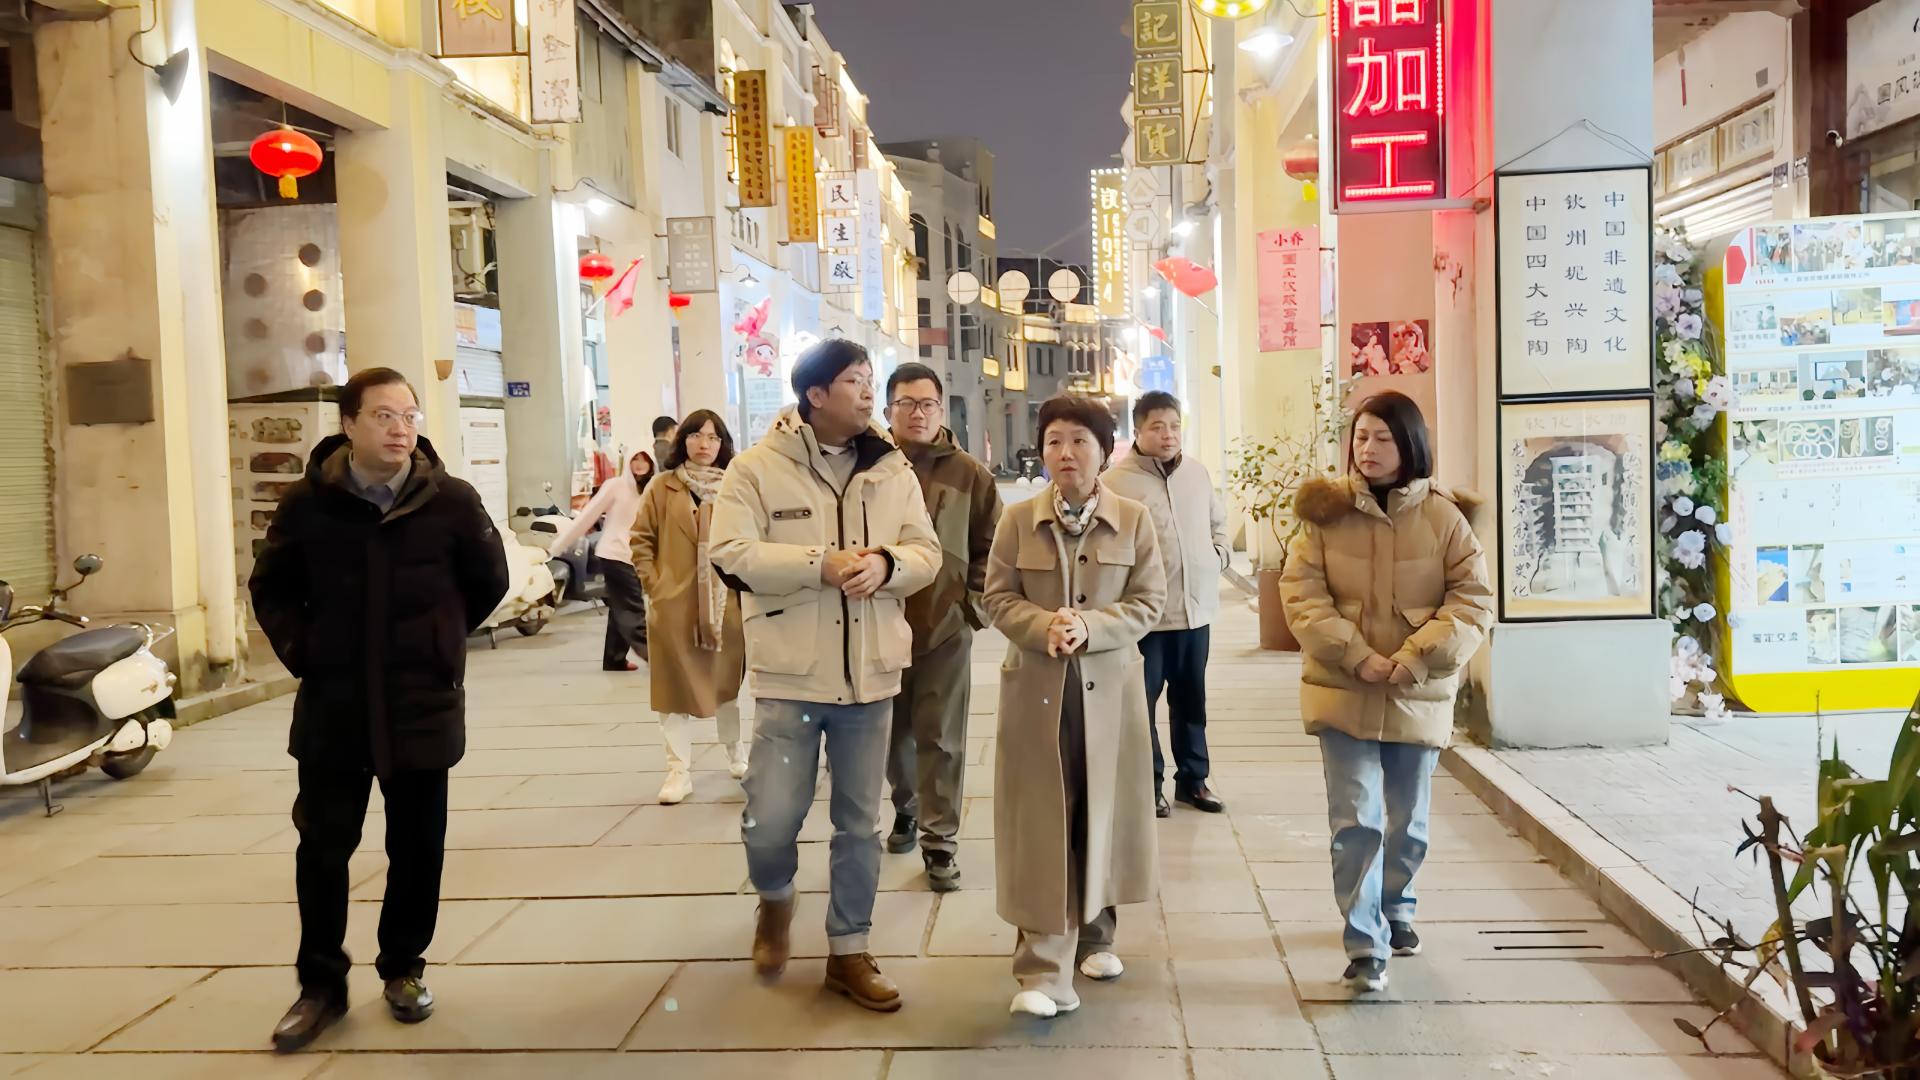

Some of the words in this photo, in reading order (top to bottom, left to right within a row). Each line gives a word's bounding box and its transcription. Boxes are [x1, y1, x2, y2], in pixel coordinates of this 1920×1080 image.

[1139, 12, 1176, 158] 記洋貨
[1526, 196, 1549, 356] 中国四大名陶
[1564, 194, 1588, 354] 钦州坭兴陶
[1603, 191, 1628, 353] 中国非遗文化
